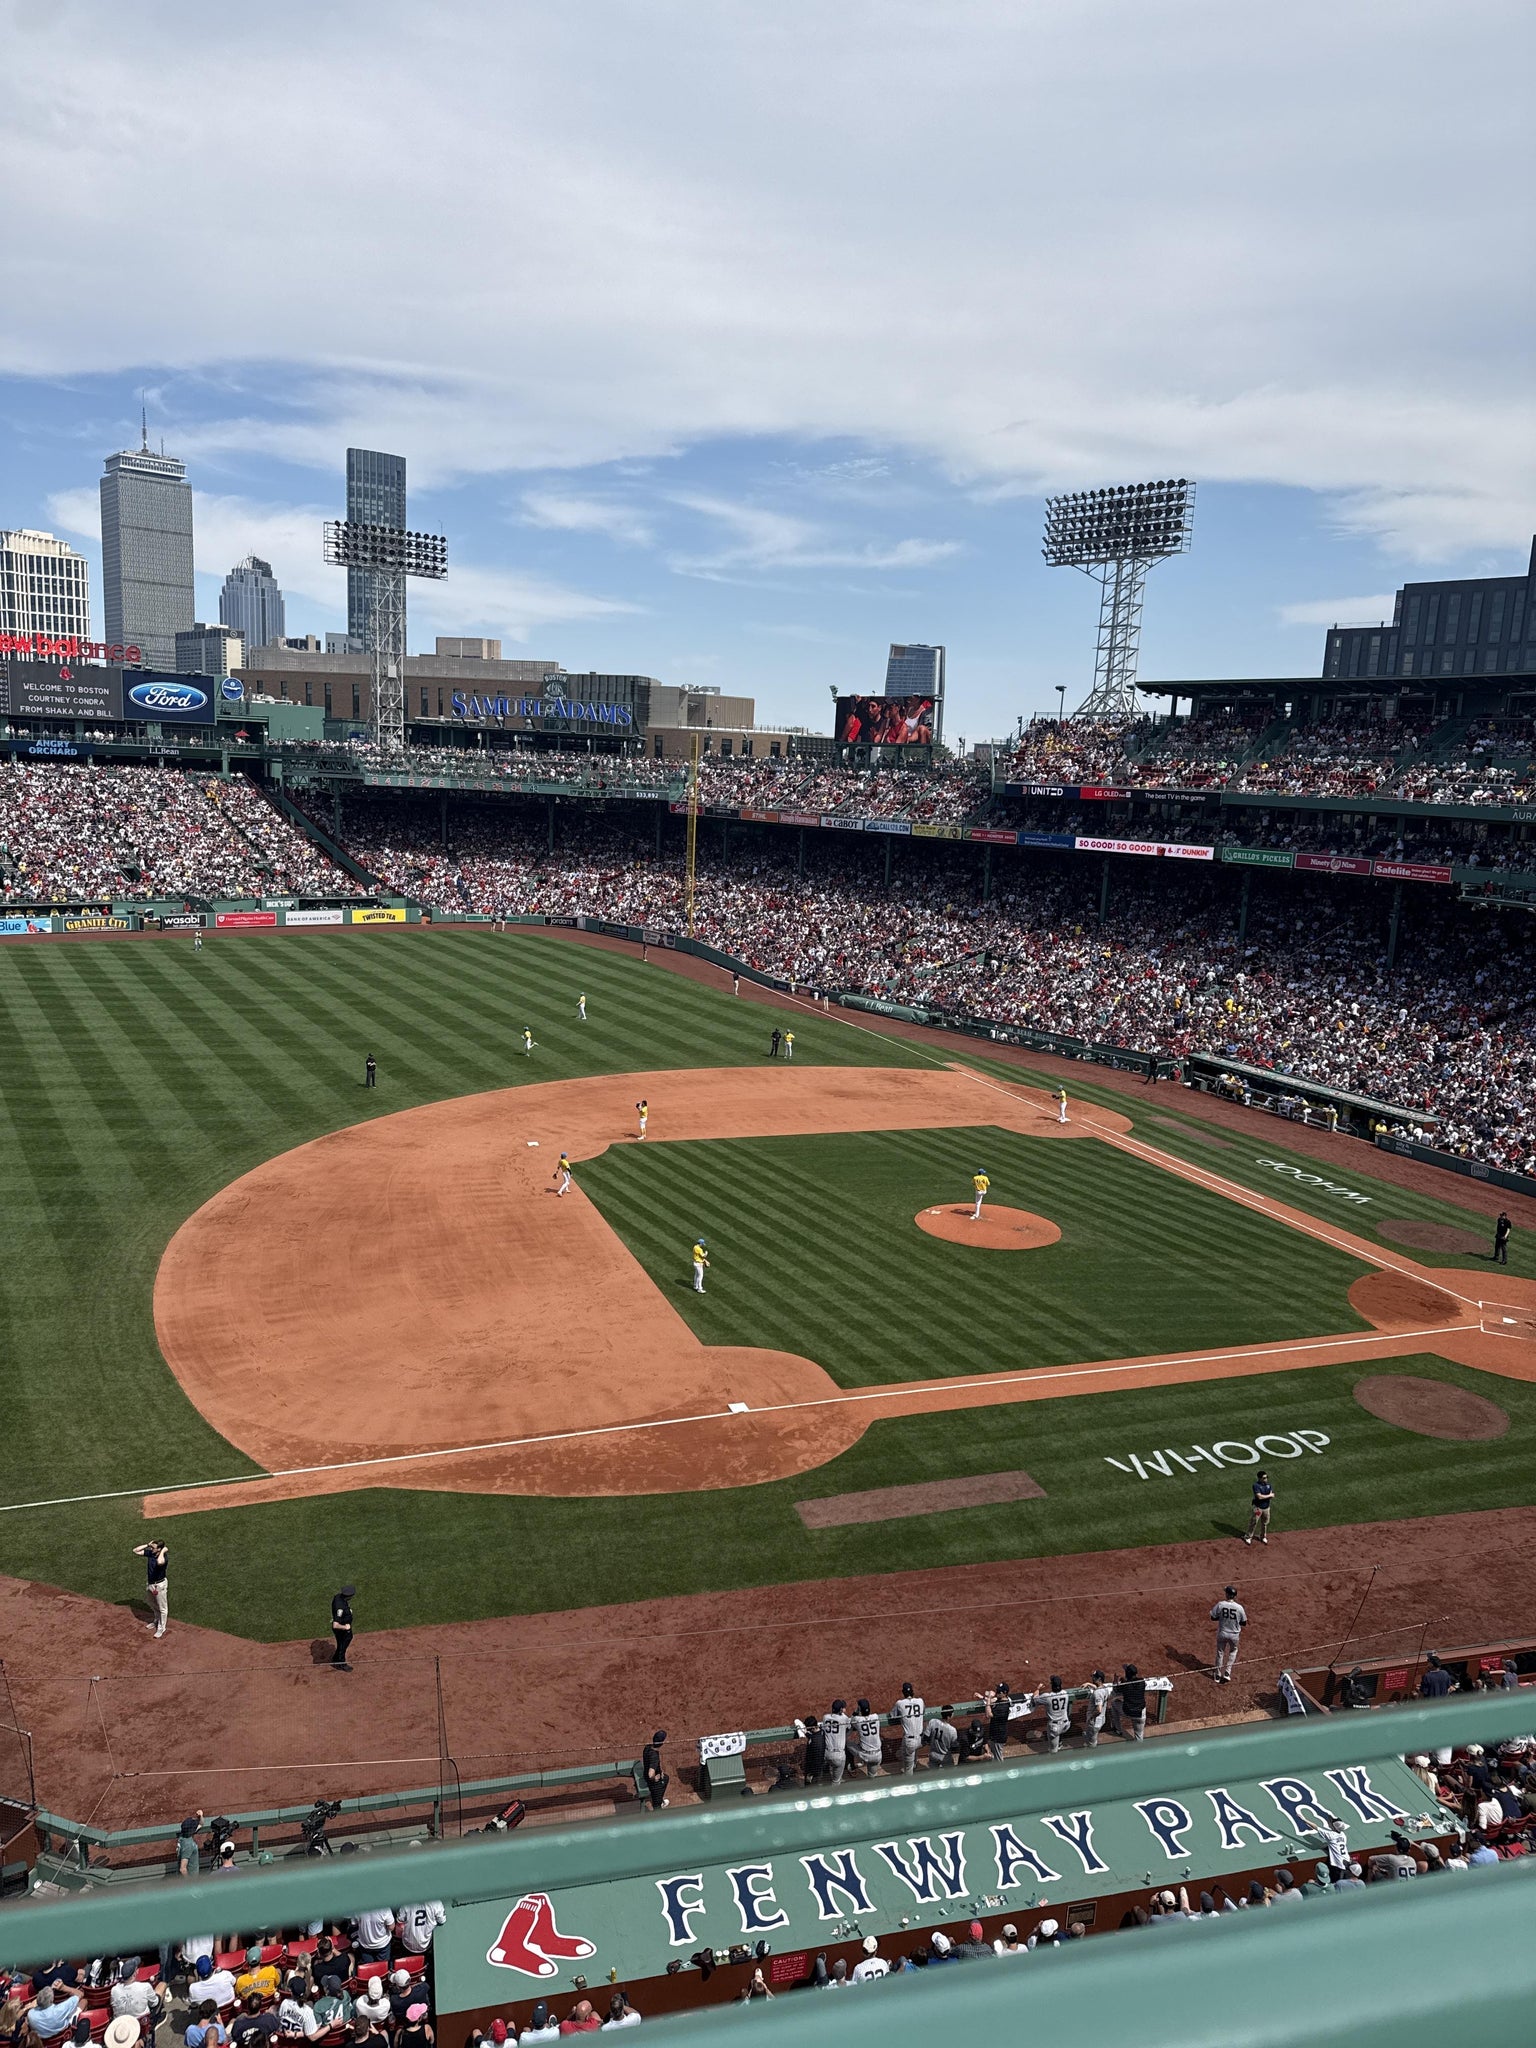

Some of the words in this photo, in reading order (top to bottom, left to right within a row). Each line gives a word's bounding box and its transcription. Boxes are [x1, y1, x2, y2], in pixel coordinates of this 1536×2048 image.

[36, 632, 142, 662] balance
[544, 674, 568, 684] BOSTON
[23, 683, 62, 692] WELCOME
[65, 685, 75, 694] TO
[78, 686, 110, 695] BOSTON
[28, 695, 71, 704] COURTNEY
[73, 697, 105, 706] CONDRA
[144, 686, 192, 708] Ford
[20, 705, 43, 714] FROM
[45, 707, 74, 715] SHAKA
[78, 708, 94, 717] AND
[97, 709, 114, 718] BILL
[451, 692, 545, 718] SAMUEL
[549, 696, 632, 727] ADAMS
[36, 740, 69, 748] ANGRY
[28, 746, 78, 756] ORCHARD
[1031, 787, 1064, 796] UNITED
[1090, 841, 1116, 850] GOOD!
[1128, 845, 1155, 853] GOOD!
[1262, 855, 1290, 864] PICKLES
[1310, 858, 1331, 868] Ninety
[1341, 861, 1356, 869] Nine
[1375, 865, 1411, 876] Safelite
[164, 914, 200, 925] wasabi
[362, 913, 386, 921] TWISTED
[0, 921, 21, 931] Blue
[66, 920, 106, 931] GRANITE
[108, 918, 128, 928] CITY
[1255, 1159, 1373, 1204] WHOOP
[1104, 1430, 1331, 1480] WHOOP
[1222, 1607, 1237, 1620] 85
[1051, 1698, 1066, 1711] 87
[904, 1705, 920, 1718] 78
[861, 1722, 877, 1736] 95
[1340, 1844, 1346, 1855] 2
[655, 1810, 1110, 1946] FENWAY
[1132, 1766, 1411, 1860] PARK
[415, 1910, 426, 1926] 2
[773, 1954, 806, 1965] CAUTION!
